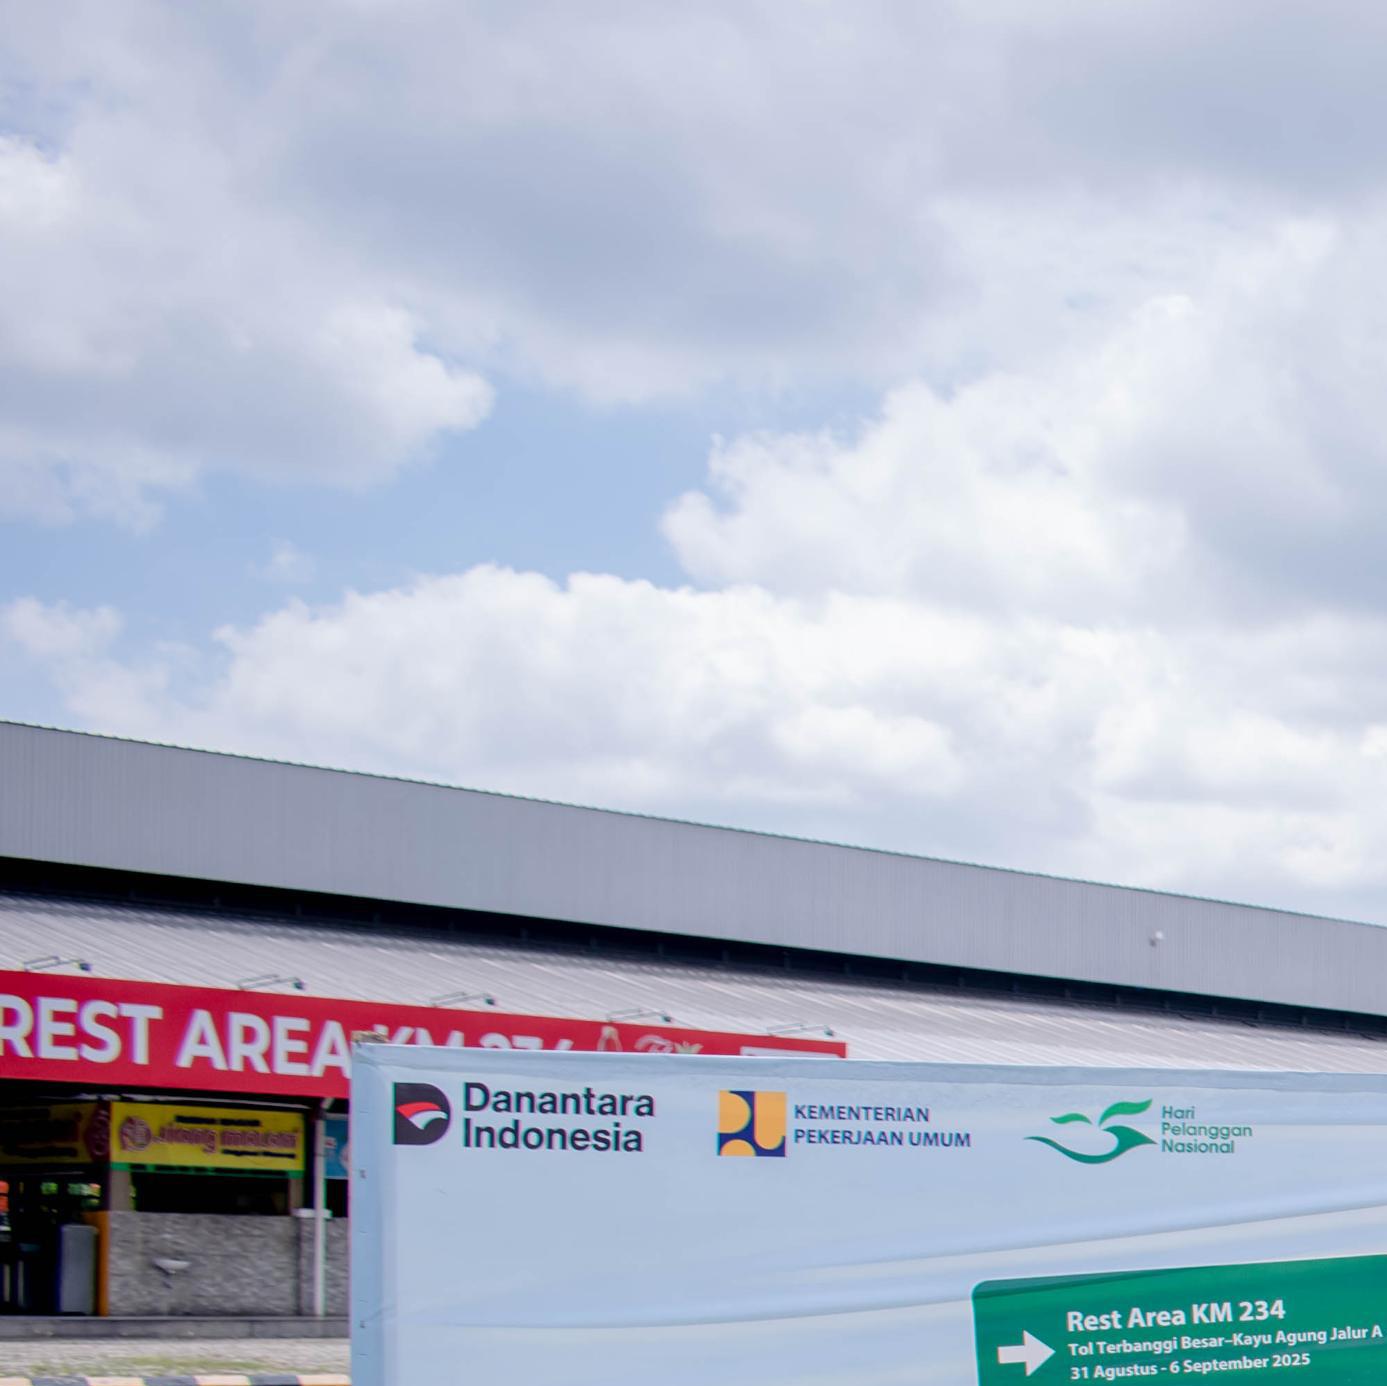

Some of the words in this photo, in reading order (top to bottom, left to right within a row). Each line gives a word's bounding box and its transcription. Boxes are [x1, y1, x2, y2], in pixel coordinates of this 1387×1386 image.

[0, 994, 163, 1064] REST
[175, 1008, 350, 1079] AREA
[463, 1082, 655, 1117] Danantara
[794, 1105, 930, 1122] KEMENTERIAN
[1161, 1106, 1195, 1120] Hari
[463, 1118, 643, 1152] Indonesia
[794, 1129, 903, 1146] PEKERJAAN
[908, 1132, 971, 1148] UMUM
[1161, 1122, 1253, 1140] Pelanggan
[1161, 1140, 1235, 1153] Nasional
[1067, 1310, 1122, 1332] Rest
[1127, 1307, 1186, 1328] Area
[1192, 1302, 1233, 1324] KM
[1238, 1299, 1286, 1321] 234
[1068, 1342, 1094, 1356] Tol
[1096, 1336, 1178, 1354] Terbanggi
[1275, 1330, 1327, 1346] Agung
[1330, 1325, 1368, 1341] Jalur
[1371, 1324, 1383, 1338] A
[1070, 1366, 1089, 1380] 31
[1094, 1363, 1158, 1381] Agustus
[1169, 1361, 1180, 1373] 6
[1183, 1356, 1269, 1374] September
[1272, 1353, 1311, 1367] 2025
